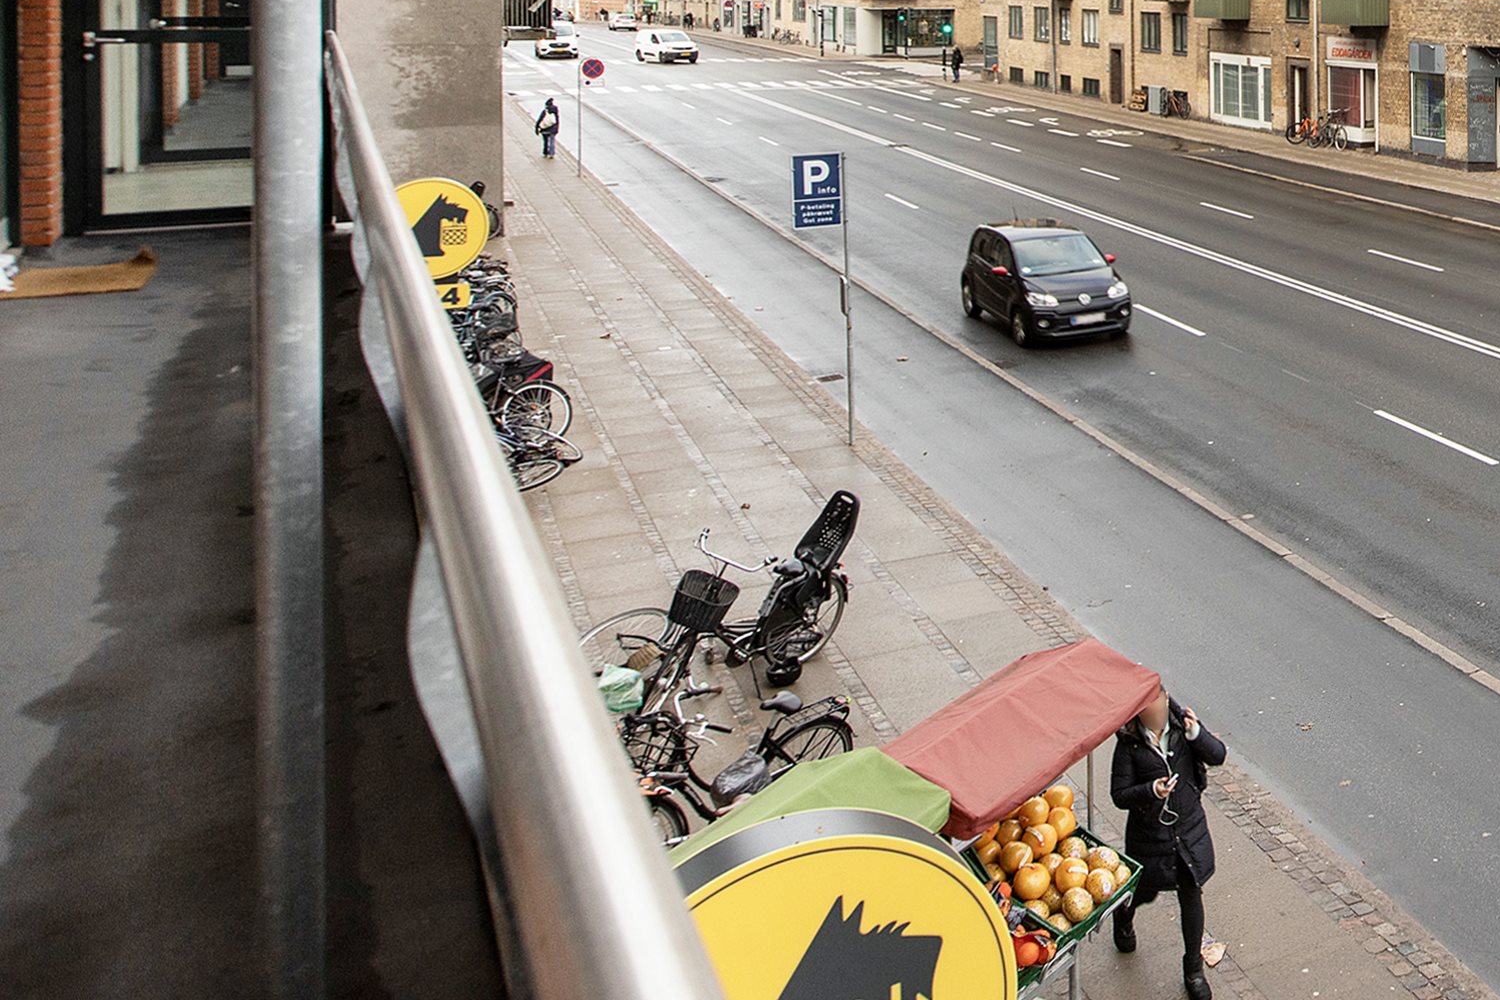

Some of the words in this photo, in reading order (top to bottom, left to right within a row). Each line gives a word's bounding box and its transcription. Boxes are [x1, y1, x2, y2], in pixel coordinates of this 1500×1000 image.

[803, 160, 830, 195] P
[817, 186, 837, 194] info
[800, 203, 834, 211] P-betaling
[802, 210, 834, 218] påkrævet
